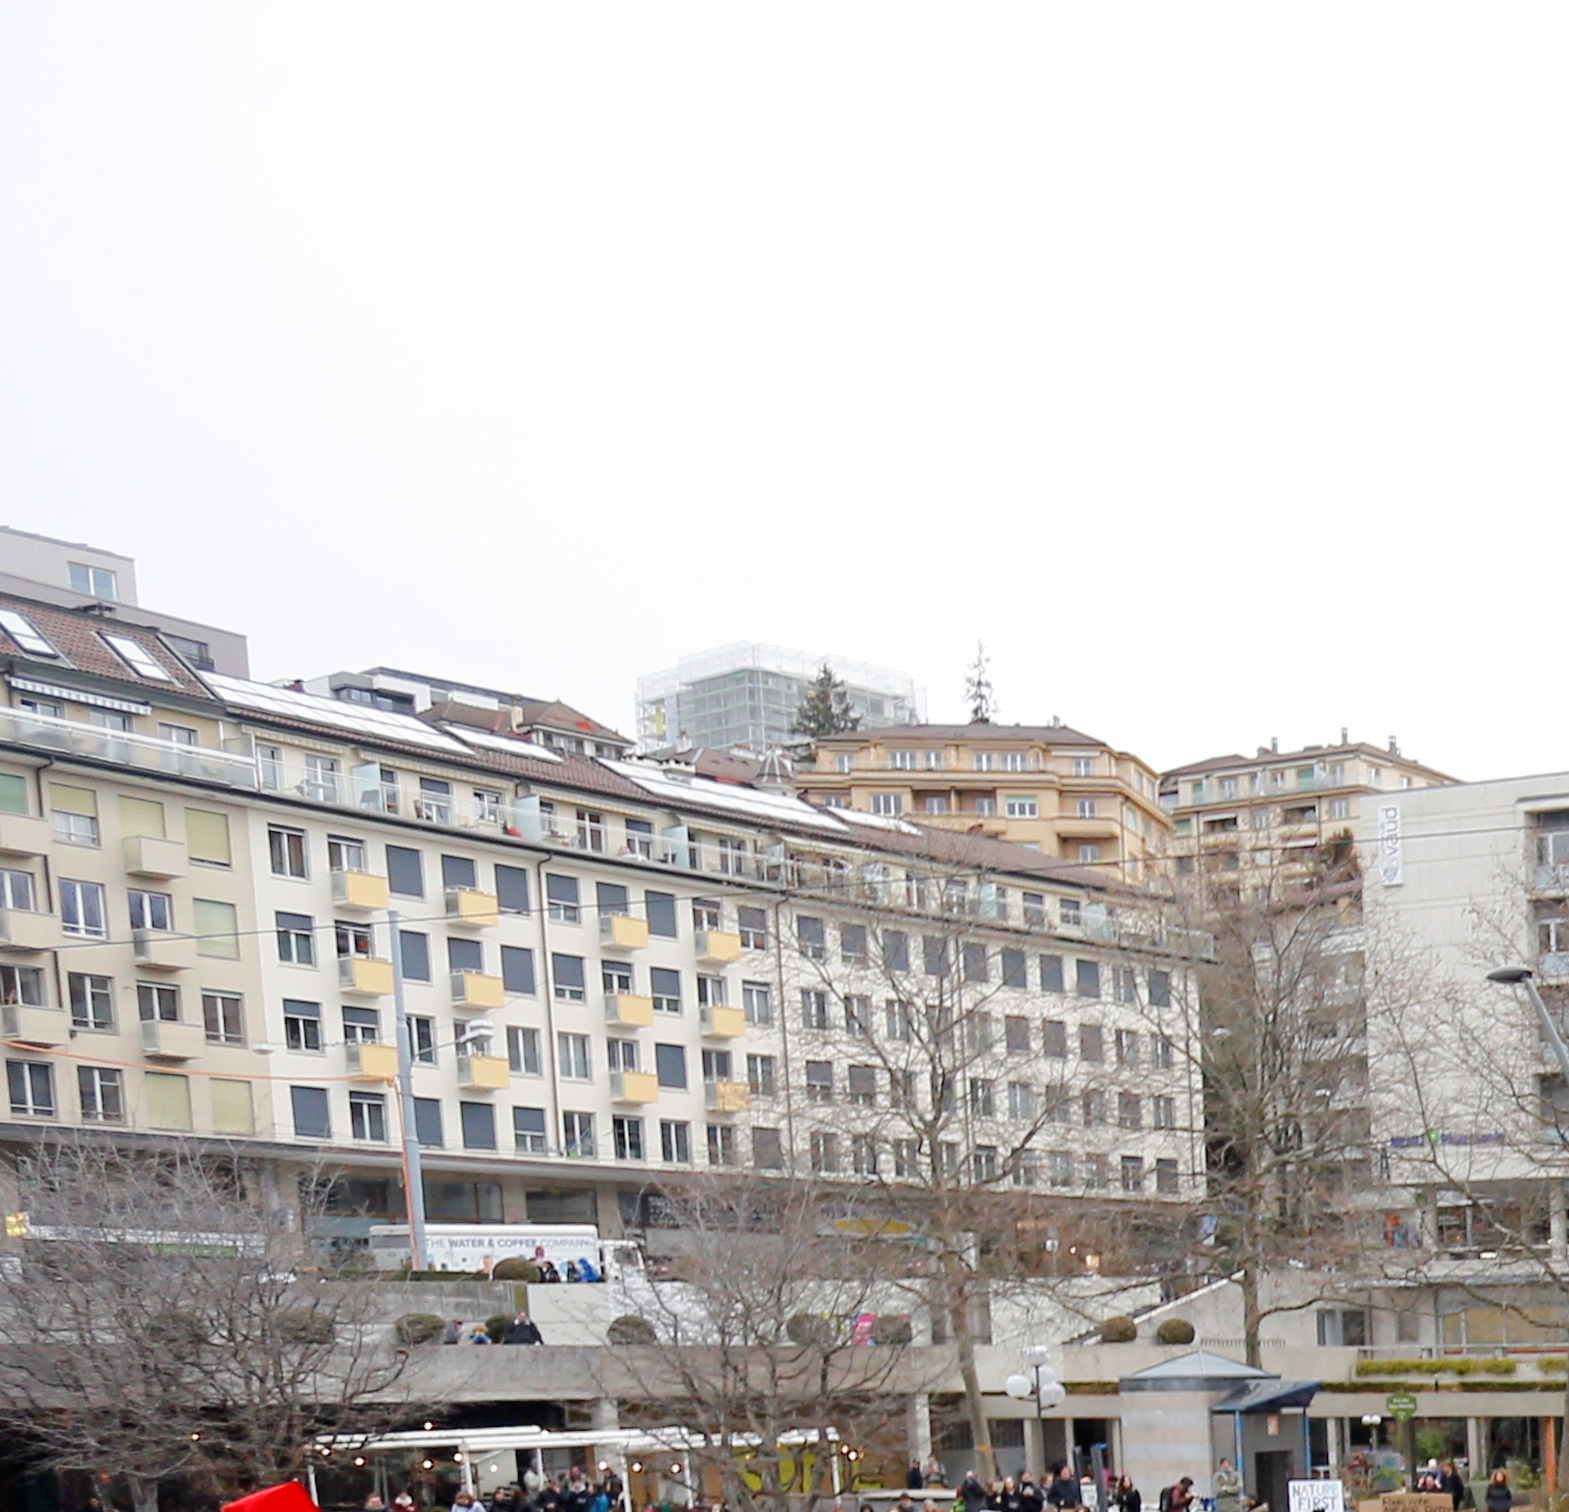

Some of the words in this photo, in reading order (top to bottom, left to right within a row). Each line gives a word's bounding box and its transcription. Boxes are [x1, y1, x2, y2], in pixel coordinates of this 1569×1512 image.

[1380, 806, 1399, 857] vaud
[447, 1238, 485, 1248] WATER
[487, 1238, 495, 1248] &
[497, 1238, 537, 1248] COFFEE
[539, 1238, 594, 1248] COMPANY
[1292, 1483, 1339, 1498] NATURE
[1298, 1497, 1338, 1511] FIRST
